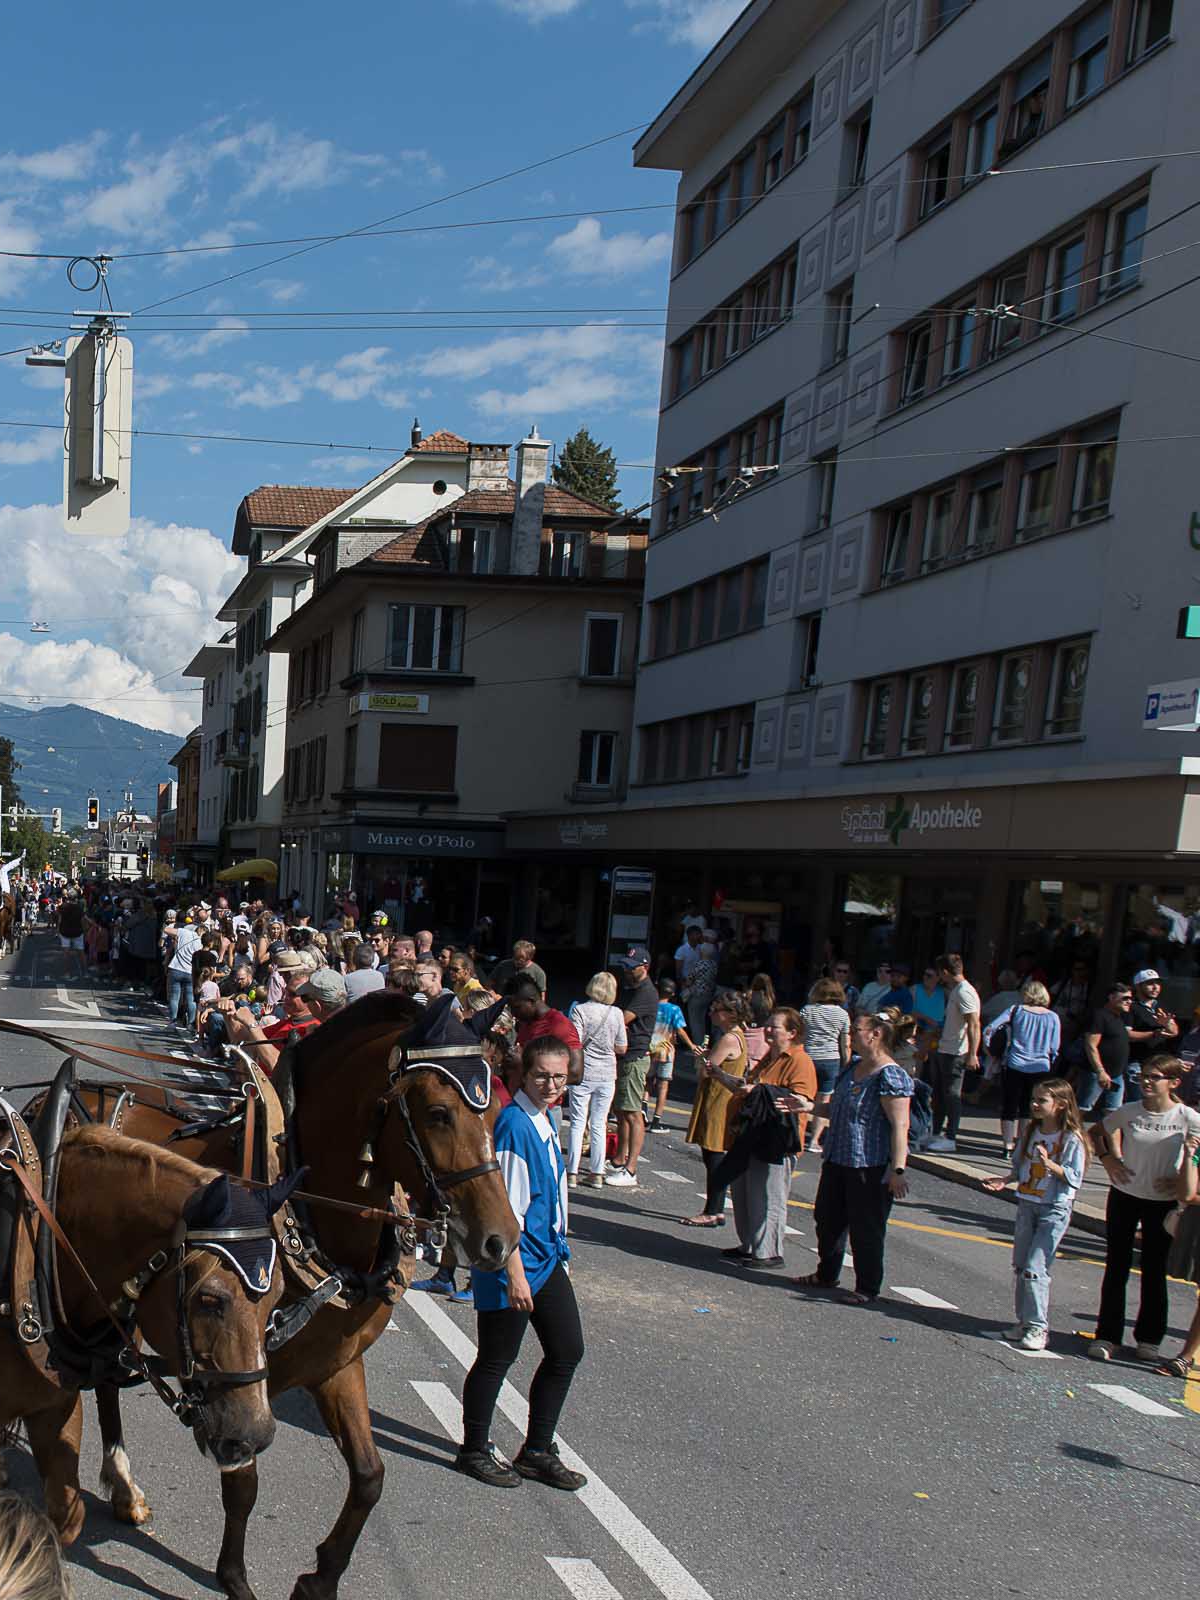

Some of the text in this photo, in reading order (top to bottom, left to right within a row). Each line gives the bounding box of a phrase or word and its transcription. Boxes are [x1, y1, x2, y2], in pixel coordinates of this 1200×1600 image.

[373, 696, 397, 705] GOLD
[1147, 698, 1158, 715] P
[909, 800, 983, 835] Apotheke
[367, 832, 476, 849] Marc O'Polo
